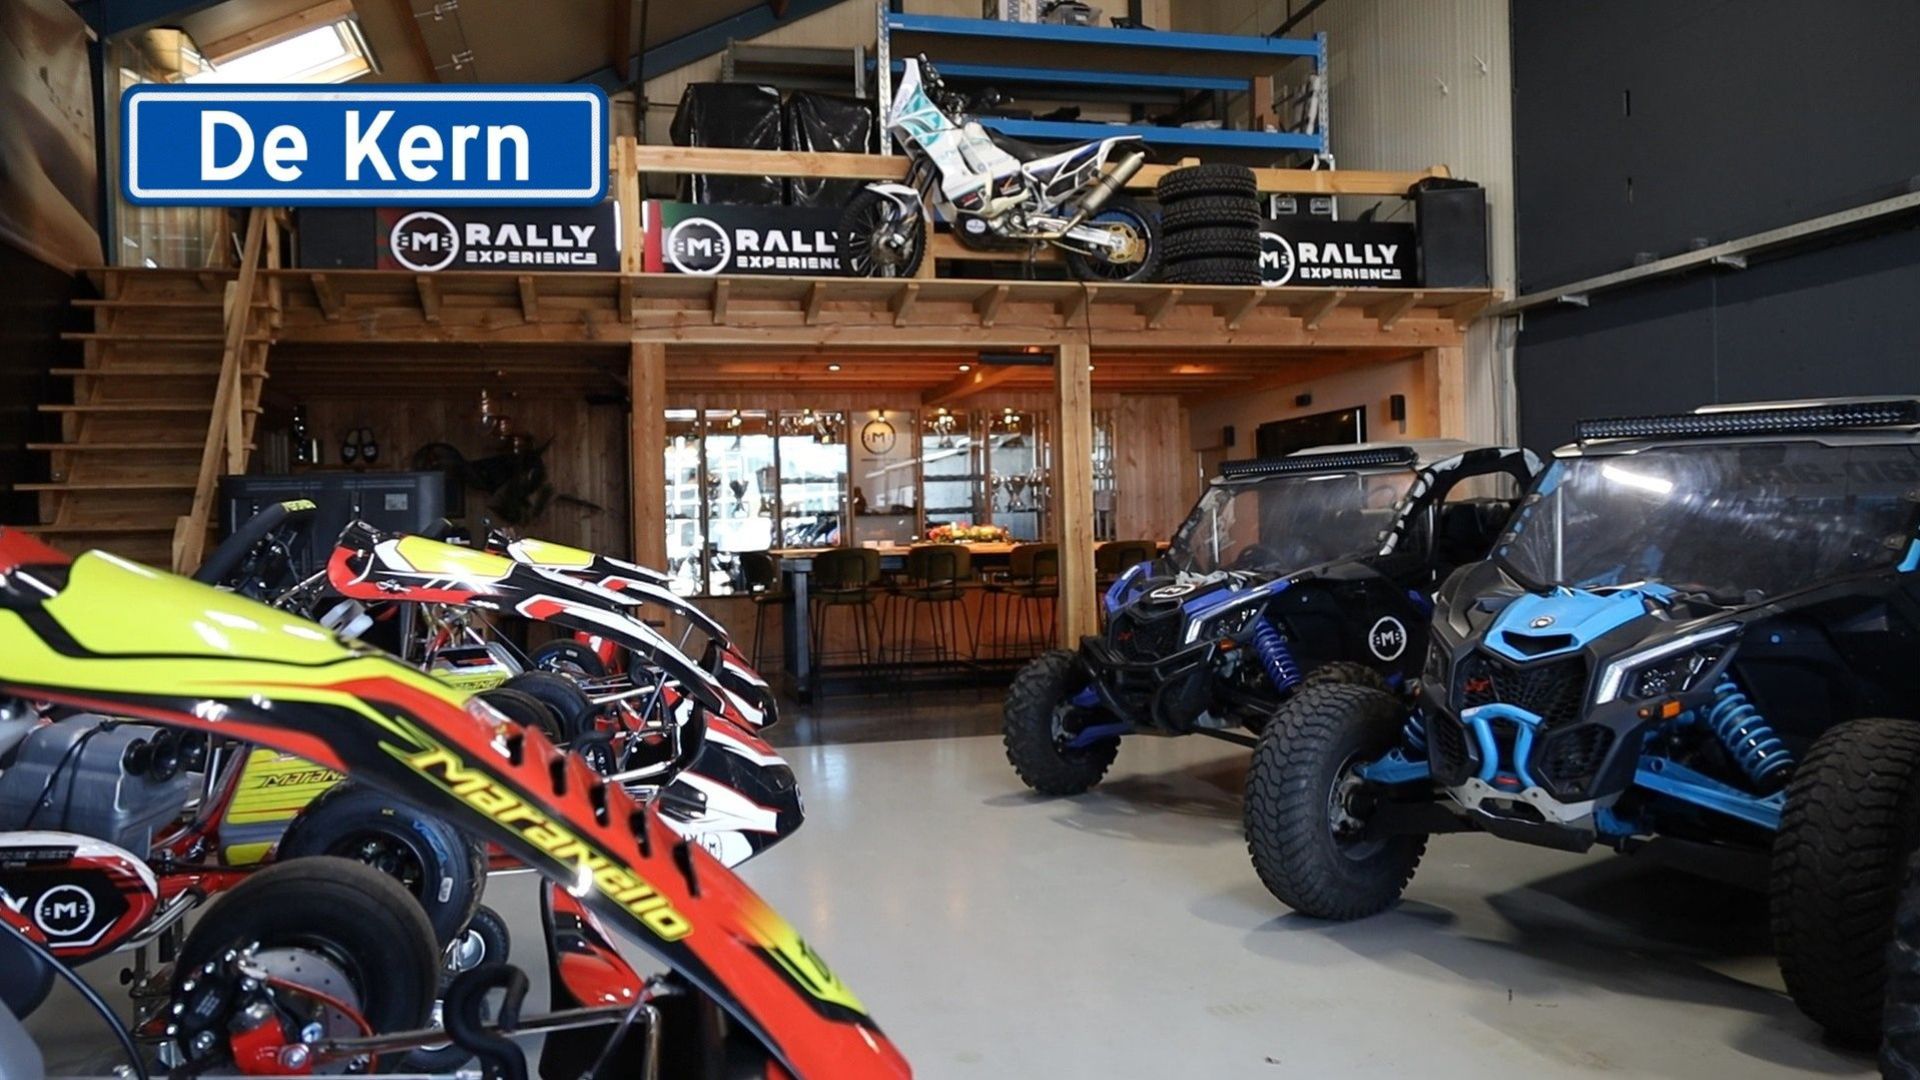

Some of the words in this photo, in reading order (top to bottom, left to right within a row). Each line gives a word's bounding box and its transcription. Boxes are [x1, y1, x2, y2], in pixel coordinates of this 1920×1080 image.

[465, 222, 596, 248] RALLY
[735, 228, 855, 253] RALL
[465, 250, 598, 265] EXPERIENCE
[1298, 242, 1399, 265] RALLY
[1300, 267, 1402, 280] EXPERIENCE
